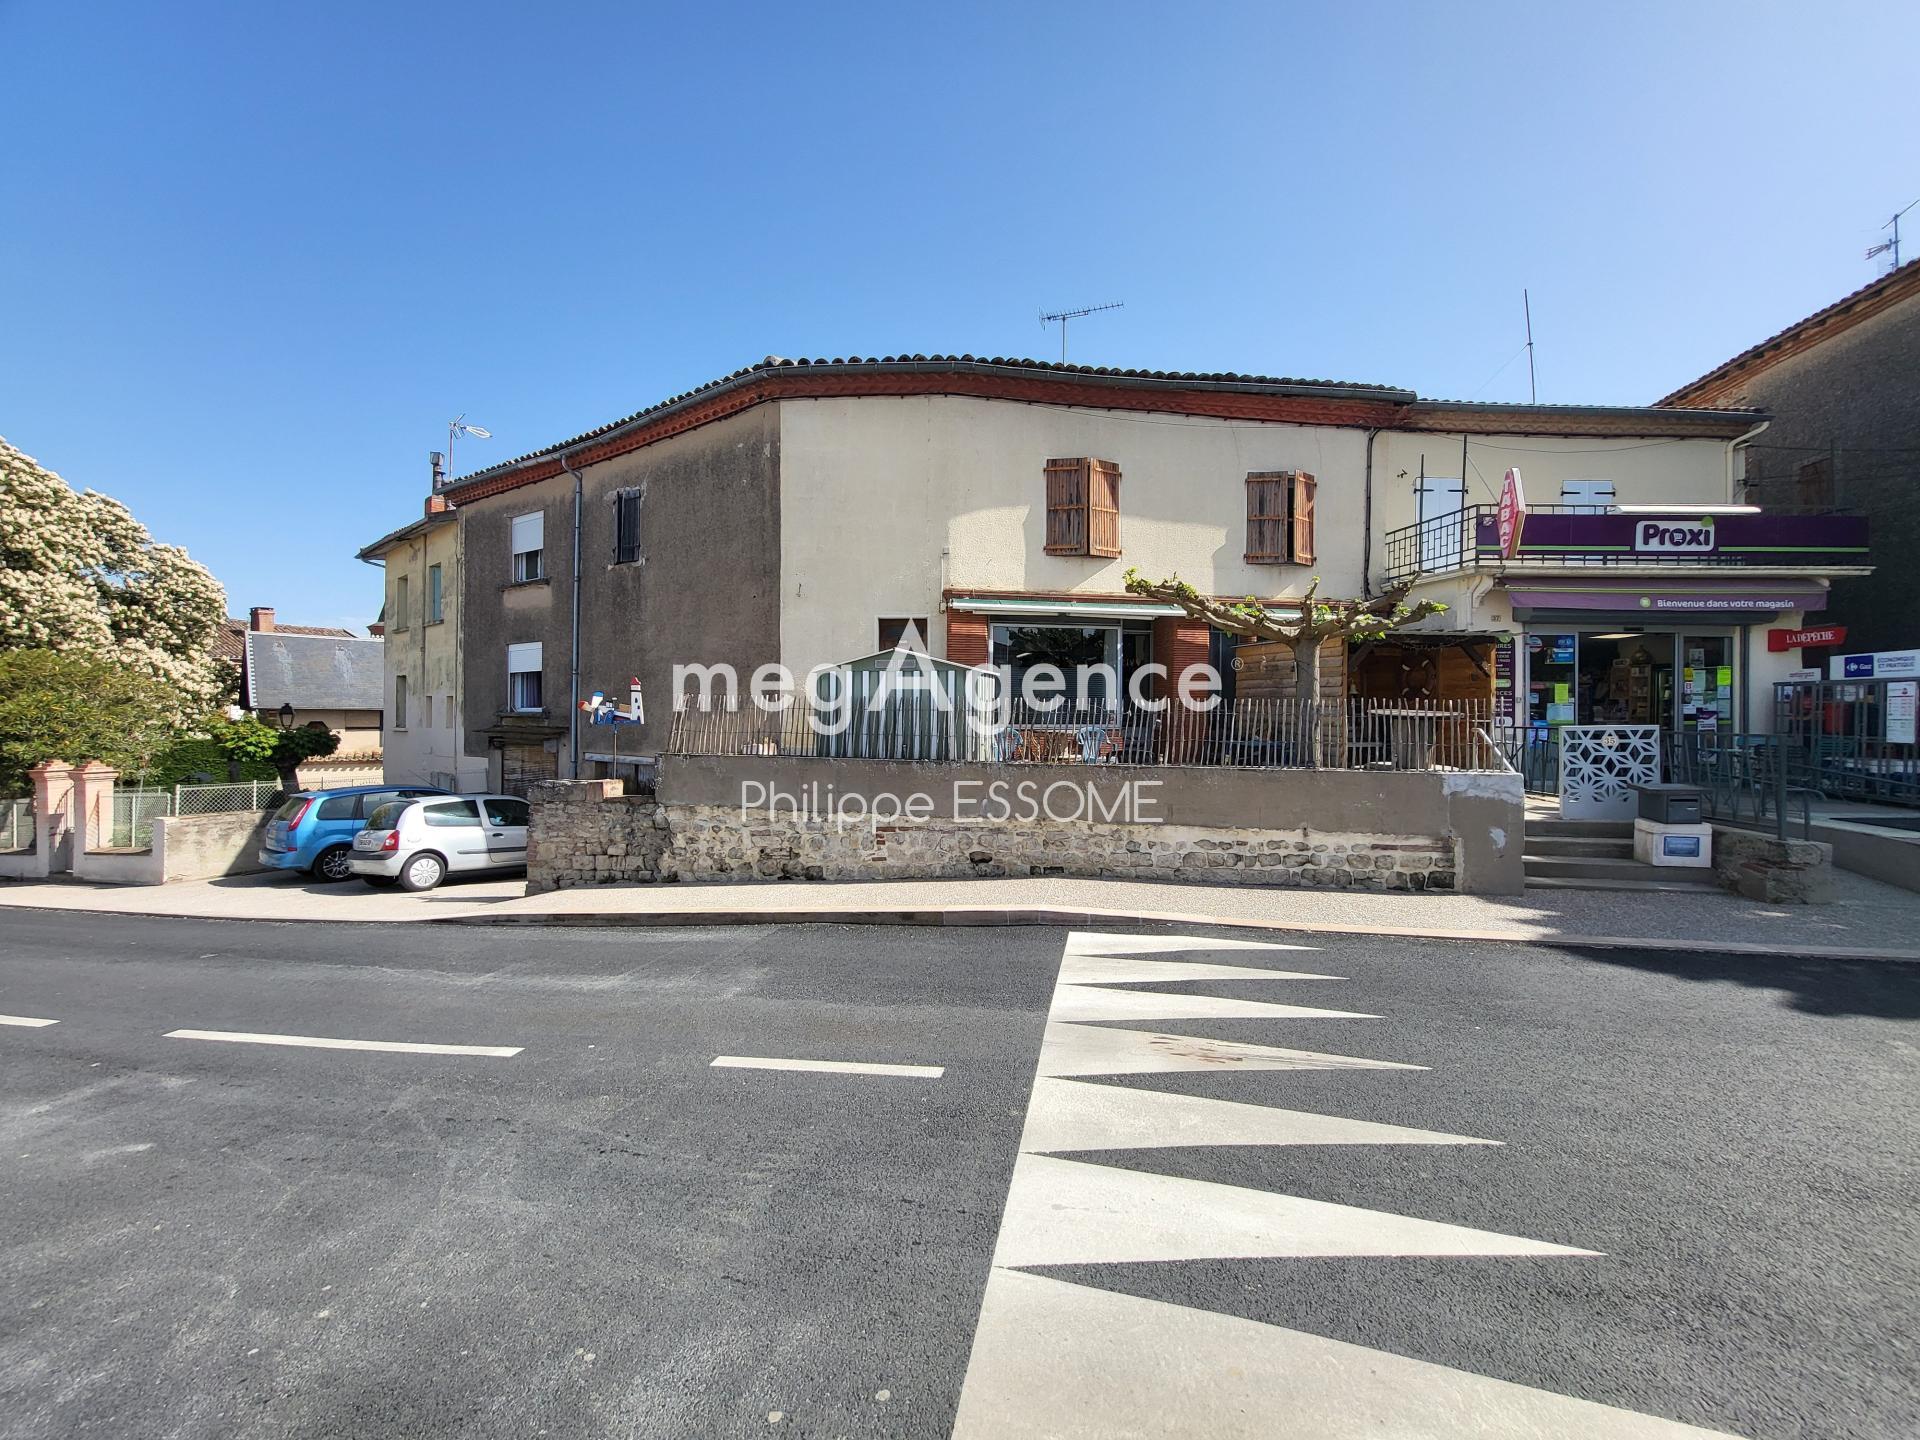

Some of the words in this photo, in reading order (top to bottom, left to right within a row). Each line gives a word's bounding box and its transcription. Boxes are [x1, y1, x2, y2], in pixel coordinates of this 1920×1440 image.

[1500, 479, 1511, 549] TABAC
[1643, 523, 1711, 546] Proxi
[1657, 599, 1705, 608] Bienvenue
[1706, 599, 1729, 608] dans
[1729, 600, 1754, 608] votre
[1755, 599, 1794, 610] magasin
[1786, 634, 1797, 643] LA
